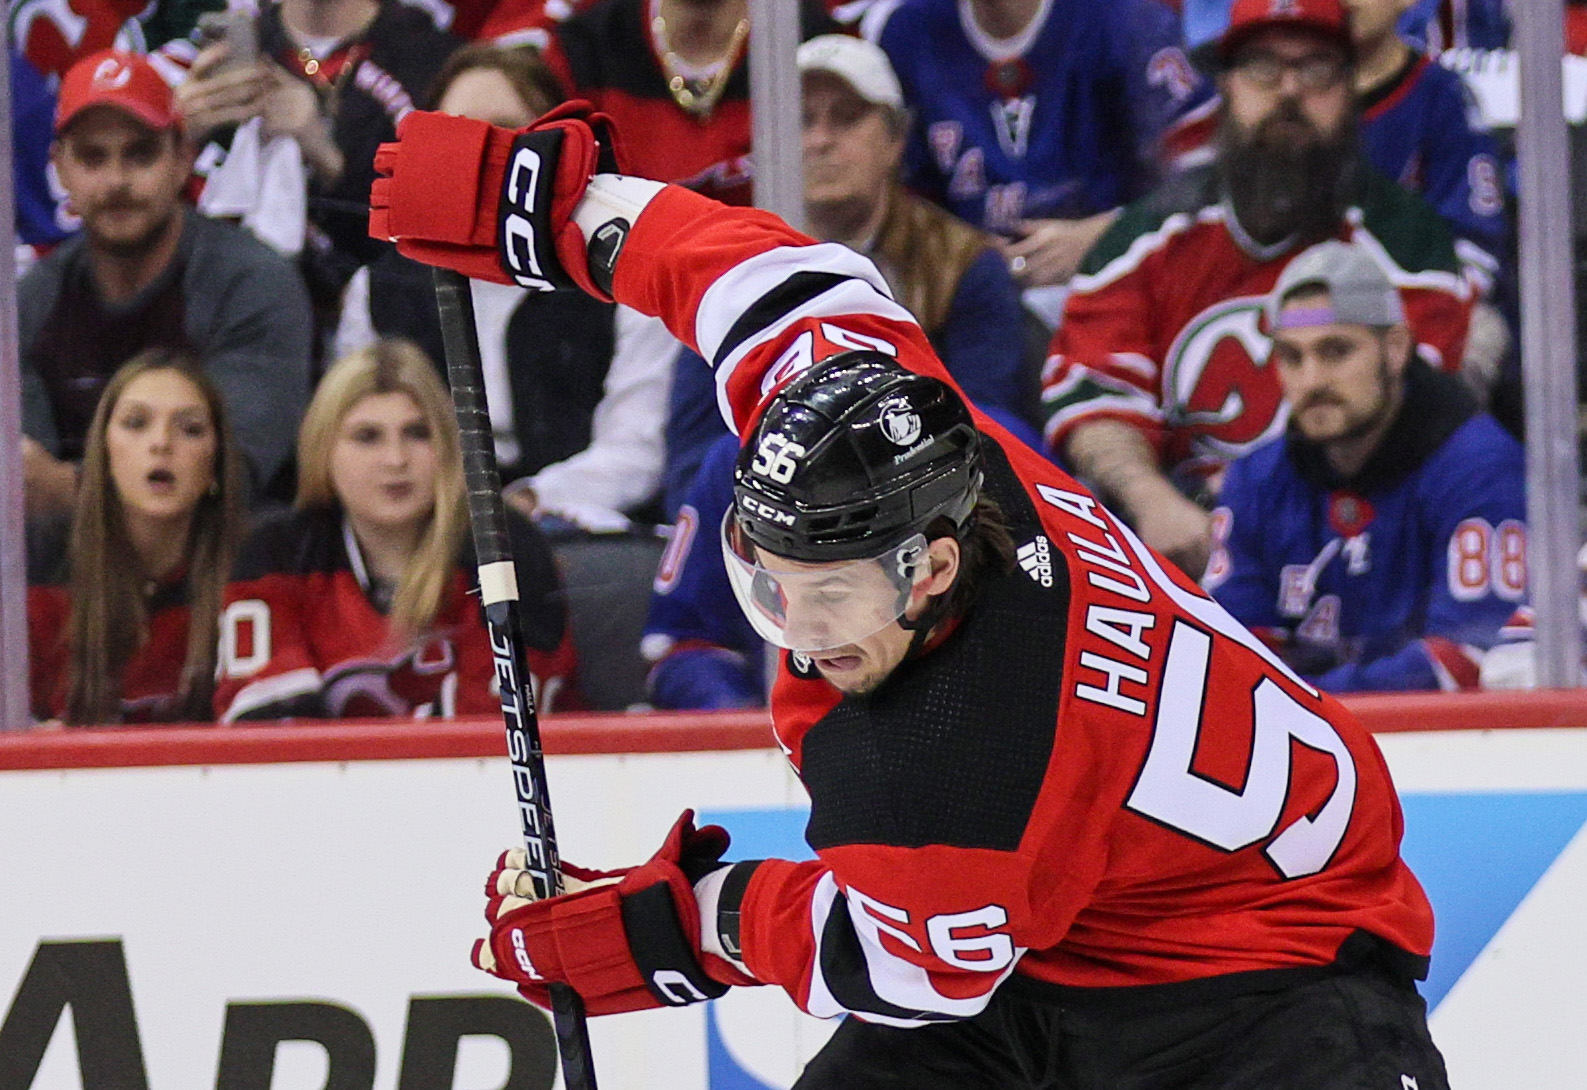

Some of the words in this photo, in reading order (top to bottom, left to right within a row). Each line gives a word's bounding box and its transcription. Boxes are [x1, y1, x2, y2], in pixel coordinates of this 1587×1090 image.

[751, 432, 806, 485] 56
[742, 498, 797, 528] CCM
[1034, 535, 1053, 588] adidas
[1035, 476, 1155, 716] HAULA
[1447, 516, 1529, 602] 88
[213, 598, 272, 683] 0
[1105, 503, 1358, 880] 5
